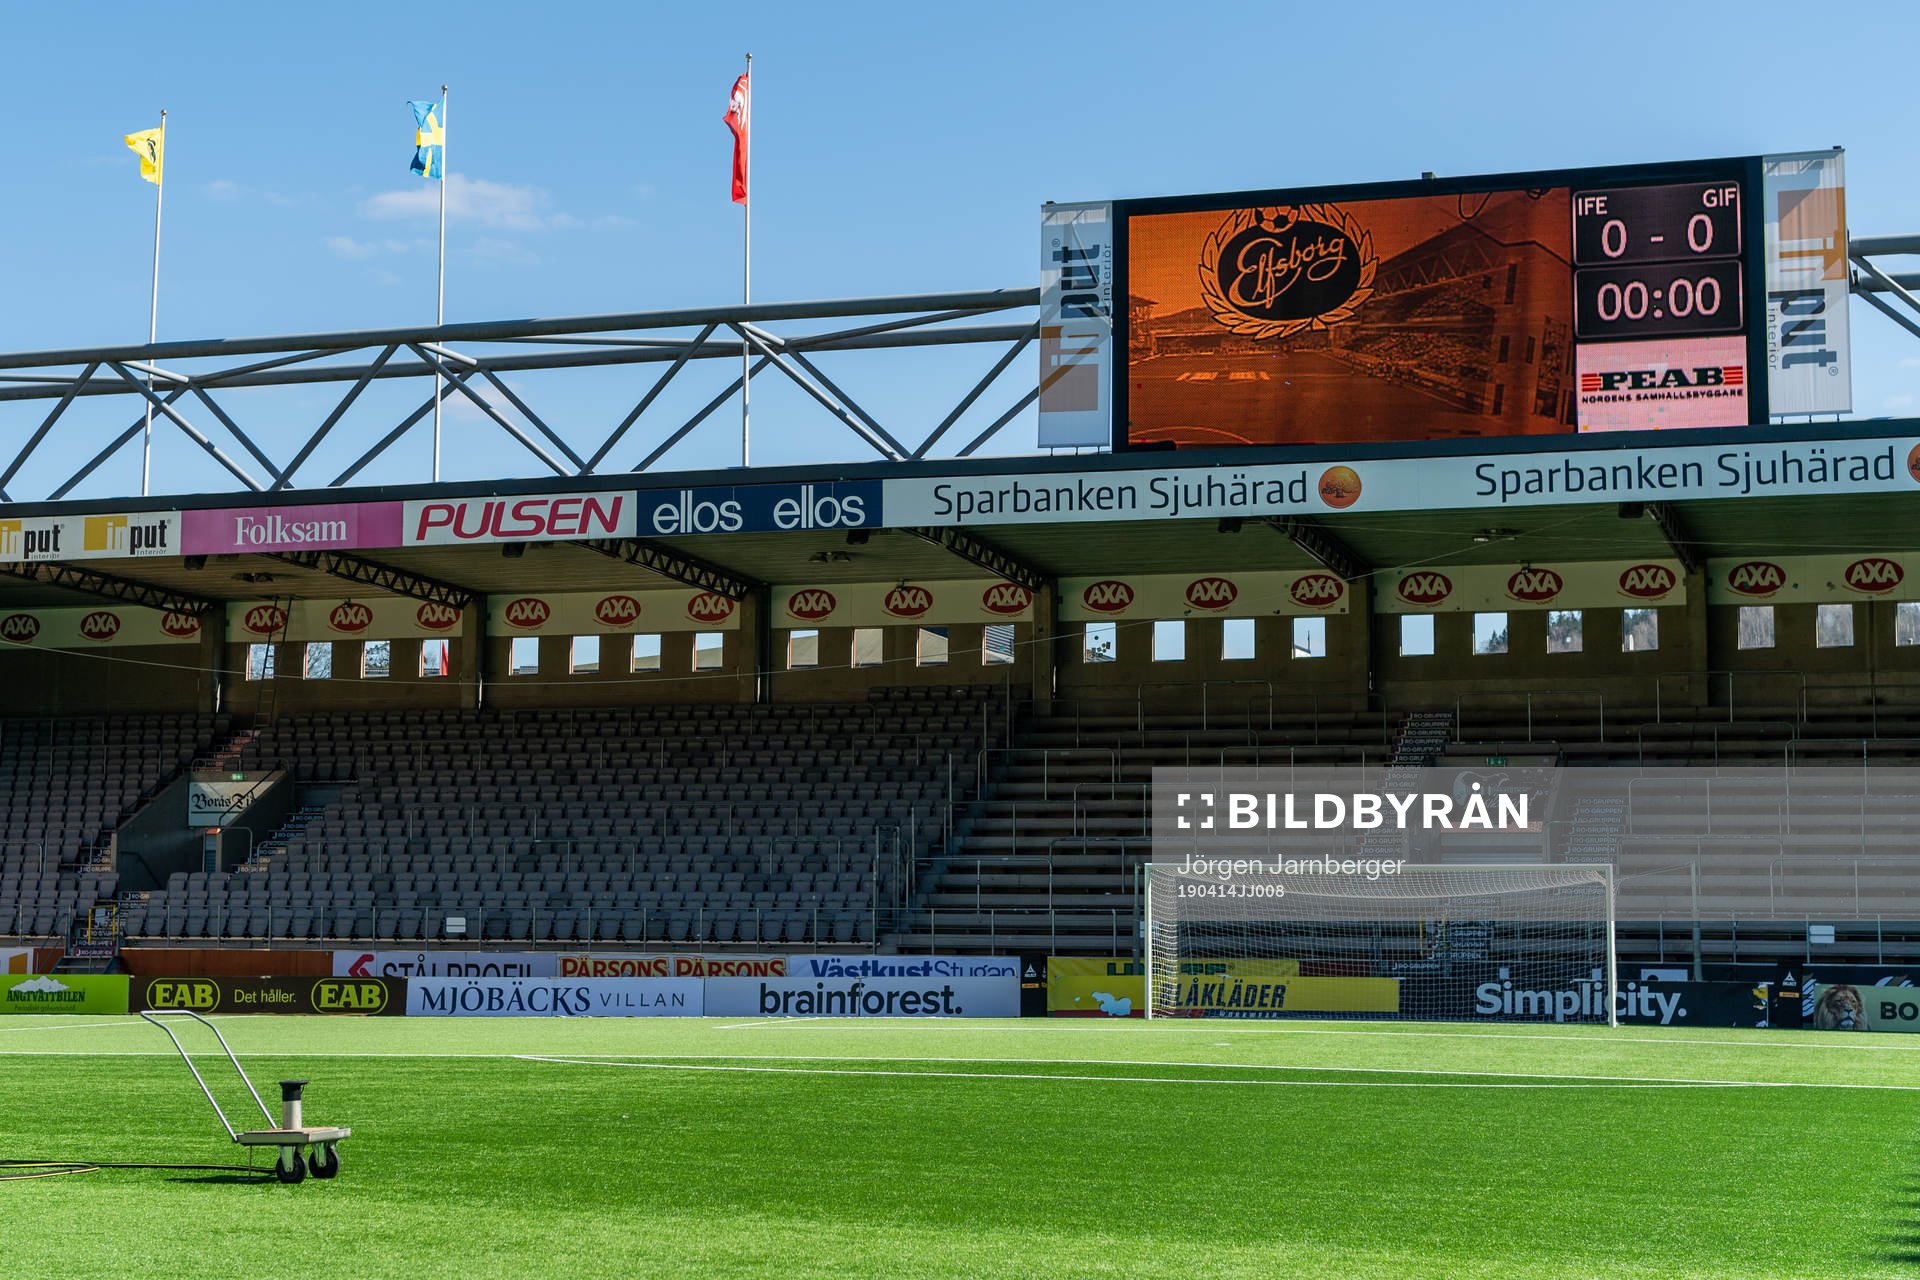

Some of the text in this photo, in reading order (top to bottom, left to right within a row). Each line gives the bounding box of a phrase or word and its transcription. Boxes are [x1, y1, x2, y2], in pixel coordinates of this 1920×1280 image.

[1577, 187, 1737, 216] IFE GIF
[1601, 219, 1627, 258] 0
[1687, 213, 1714, 253] 0
[1228, 236, 1347, 309] Elfsborg
[1597, 276, 1721, 321] 00:00
[1598, 366, 1724, 391] PEAB
[1475, 445, 1895, 502] Sparbanken Sjuhärad
[933, 471, 1307, 522] Sparbanken Sjuhärad
[416, 496, 623, 541] PULSEN
[652, 484, 865, 535] ellos ellos
[106, 519, 167, 555] input
[234, 515, 348, 547] Folksam
[1, 524, 60, 560] input
[1512, 575, 1559, 594] AXA
[1623, 571, 1672, 591] AXA
[1733, 570, 1780, 589] AXA
[1849, 565, 1898, 585] AXA
[1088, 586, 1130, 604] AXA
[1190, 584, 1233, 602] AXA
[1294, 581, 1339, 599] AXA
[1402, 578, 1447, 597] AXA
[689, 597, 732, 614] AXA
[792, 594, 833, 611] AXA
[887, 592, 928, 610] AXA
[986, 589, 1028, 607] AXA
[248, 610, 288, 627] AXA
[332, 607, 371, 625] AXA
[418, 604, 461, 622] AXA
[508, 602, 548, 620] AXA
[597, 600, 639, 618] AXA
[2, 618, 37, 636] AXA
[81, 616, 119, 633] AXA
[163, 612, 200, 629] AXA
[191, 793, 231, 810] Borås
[561, 957, 787, 977] PÄRSONS PÄRSONS
[154, 984, 380, 1007] EAB Det håller. EAB
[419, 980, 684, 1016] MJÖBÄCKS VILLAN
[760, 983, 963, 1015] brainforest.
[1476, 981, 1687, 1025] Simplicity.
